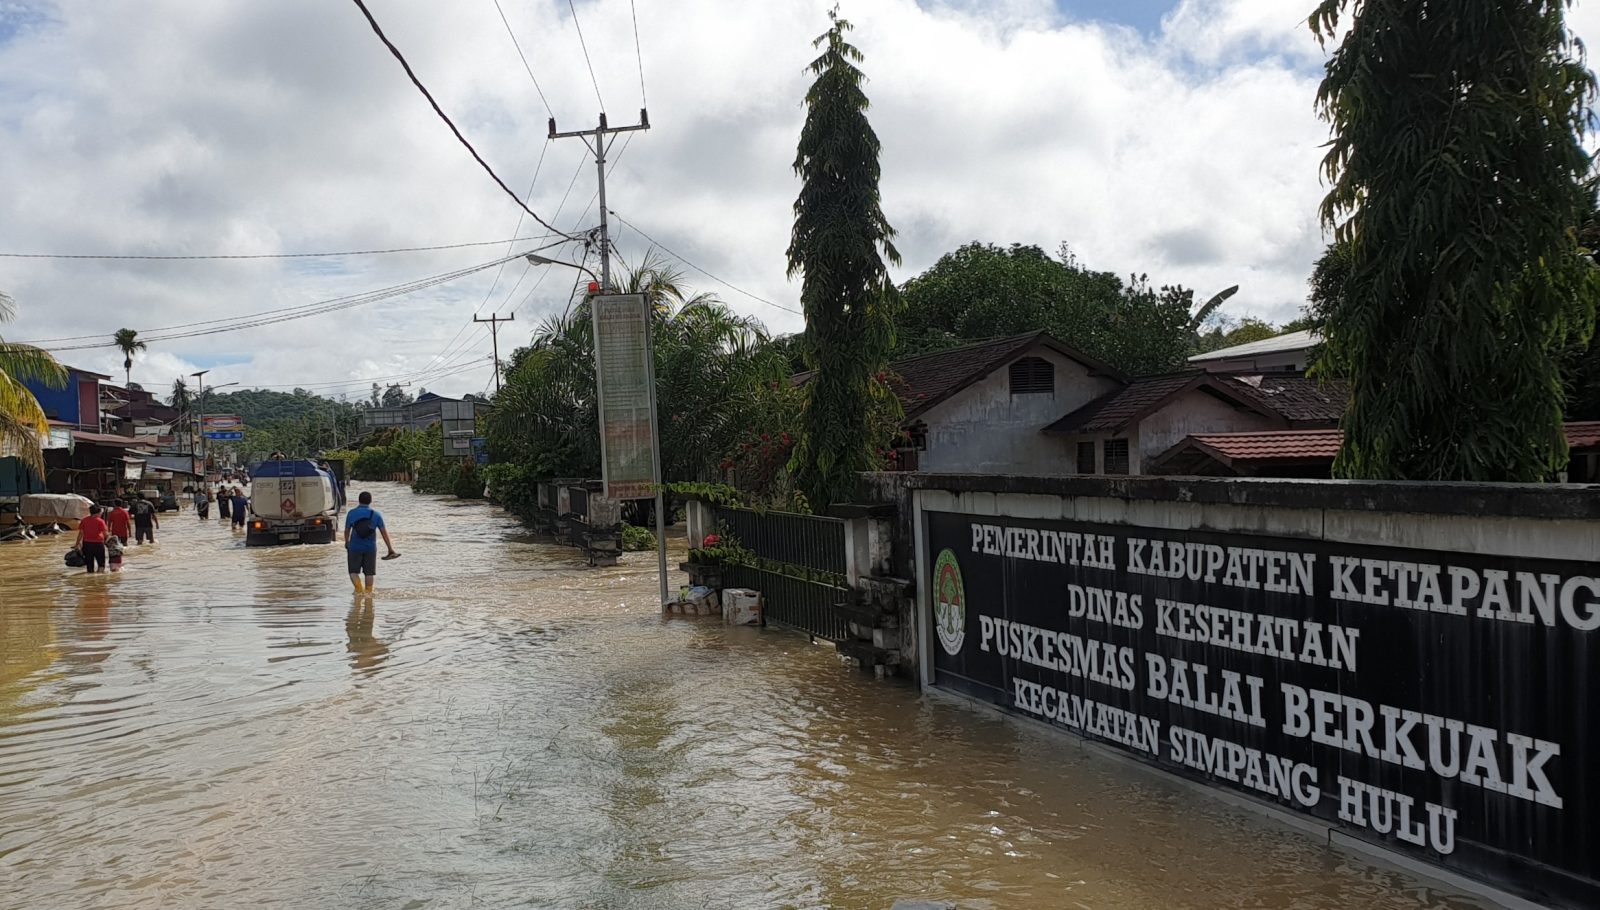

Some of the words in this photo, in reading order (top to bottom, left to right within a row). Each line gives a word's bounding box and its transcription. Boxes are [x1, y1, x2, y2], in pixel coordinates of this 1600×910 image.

[970, 523, 1116, 571] PEMERINTAH
[1127, 538, 1316, 596] KABUPATEN
[1329, 556, 1600, 631] KETAPANG
[1067, 584, 1144, 630] DINAS
[1155, 598, 1360, 672] KESEHATAN
[979, 614, 1135, 691] PUSKESMAS
[1145, 652, 1266, 728] BALAI
[1280, 682, 1563, 810] BERKUAK
[1012, 677, 1161, 756] KECAMATAN
[1169, 725, 1321, 807] SIMPANG
[1337, 775, 1458, 855] HULU
